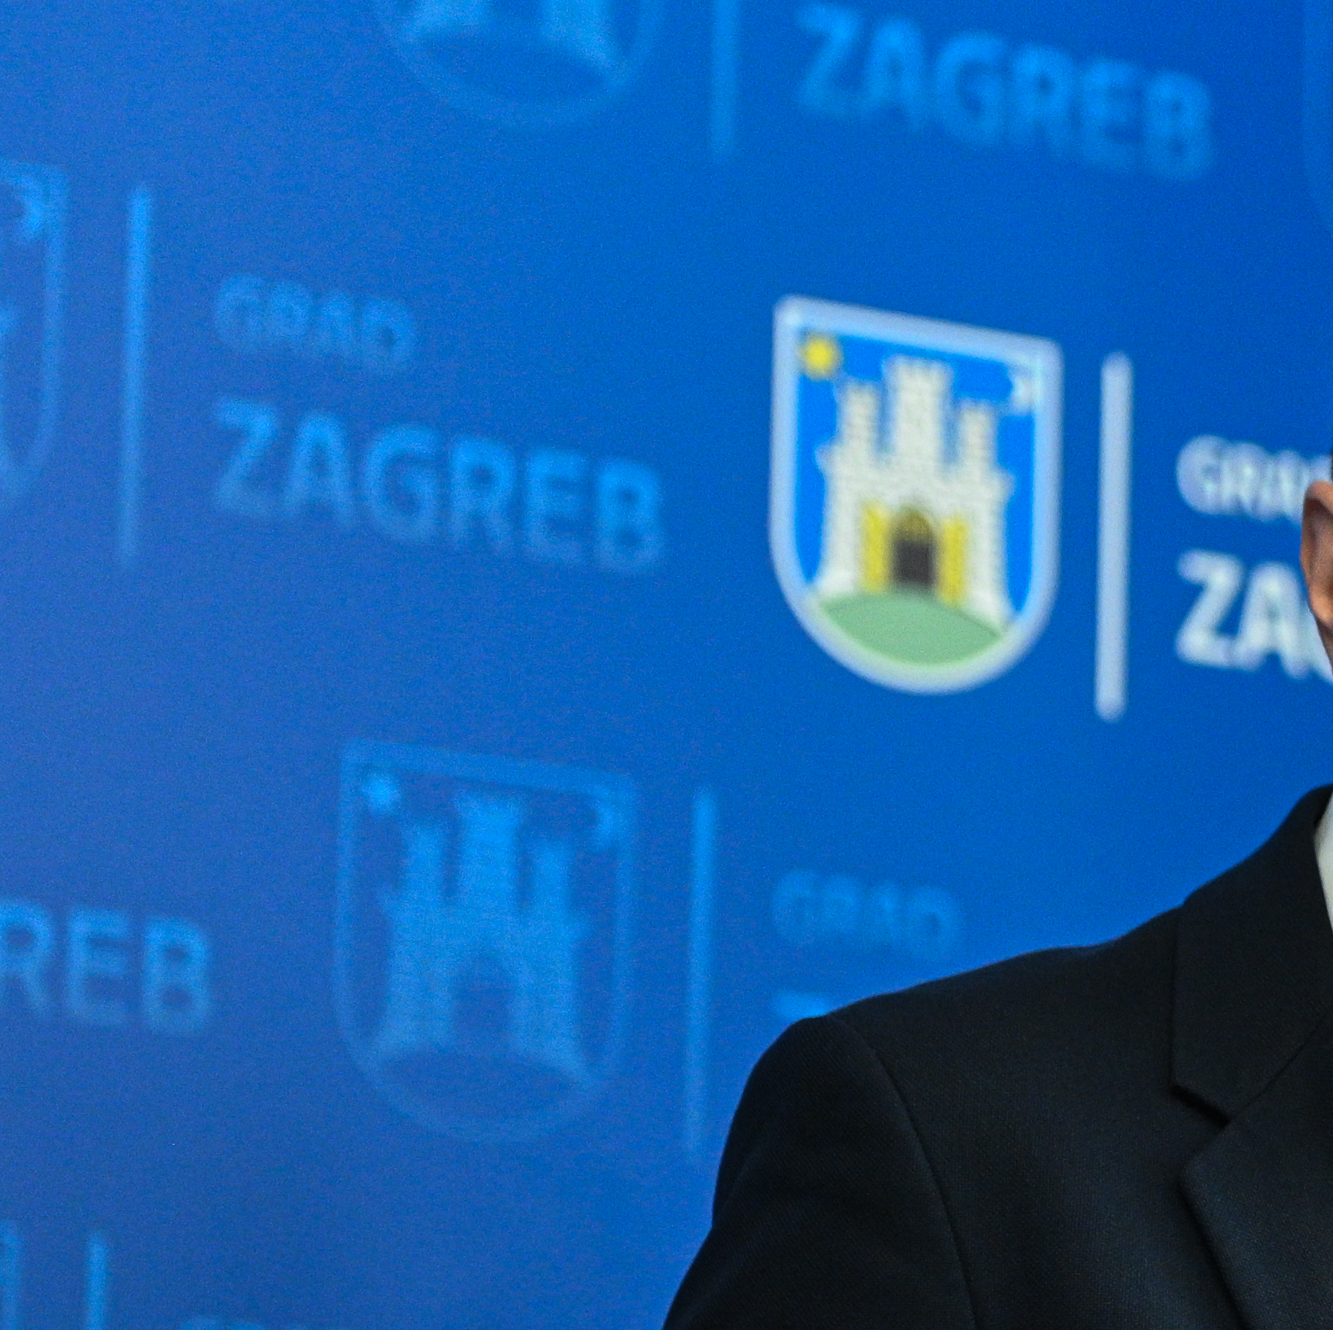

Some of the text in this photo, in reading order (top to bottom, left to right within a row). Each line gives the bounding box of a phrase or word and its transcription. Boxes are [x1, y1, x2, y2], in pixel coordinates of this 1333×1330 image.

[798, 4, 1214, 184] ZAGREB
[213, 272, 418, 370] GRAD
[213, 396, 669, 576] ZAGREB
